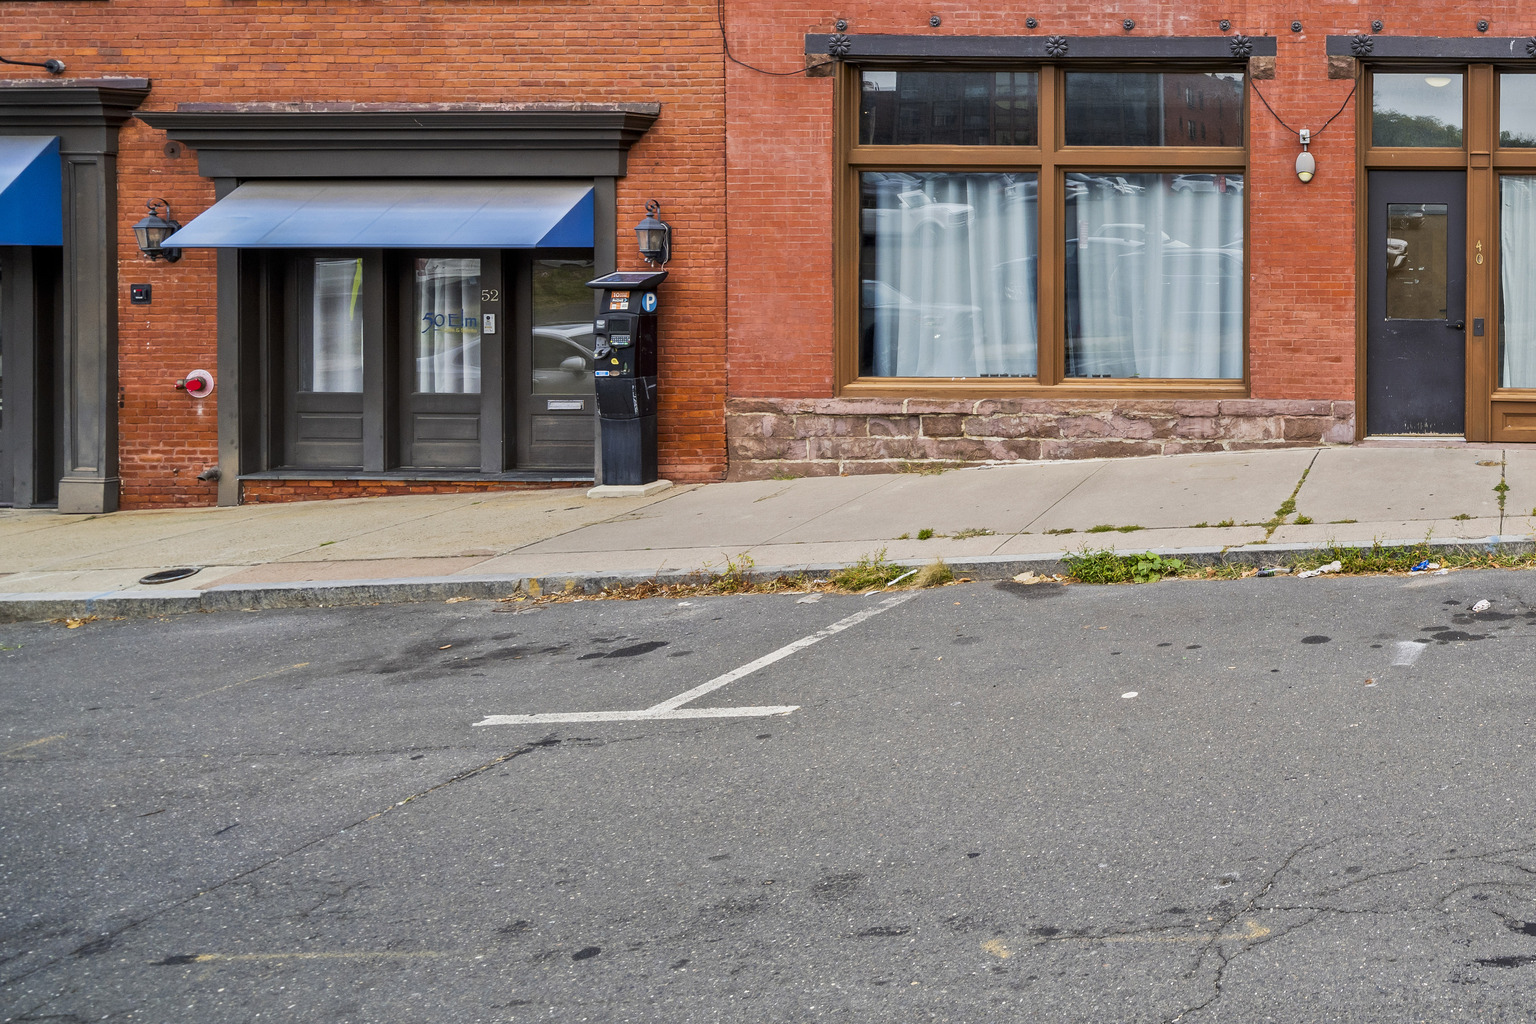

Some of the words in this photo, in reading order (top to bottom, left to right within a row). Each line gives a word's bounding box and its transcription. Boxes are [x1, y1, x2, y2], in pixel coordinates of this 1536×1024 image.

[481, 289, 499, 302] 52
[646, 293, 656, 311] P
[422, 312, 445, 333] 50
[448, 309, 477, 327] Elm
